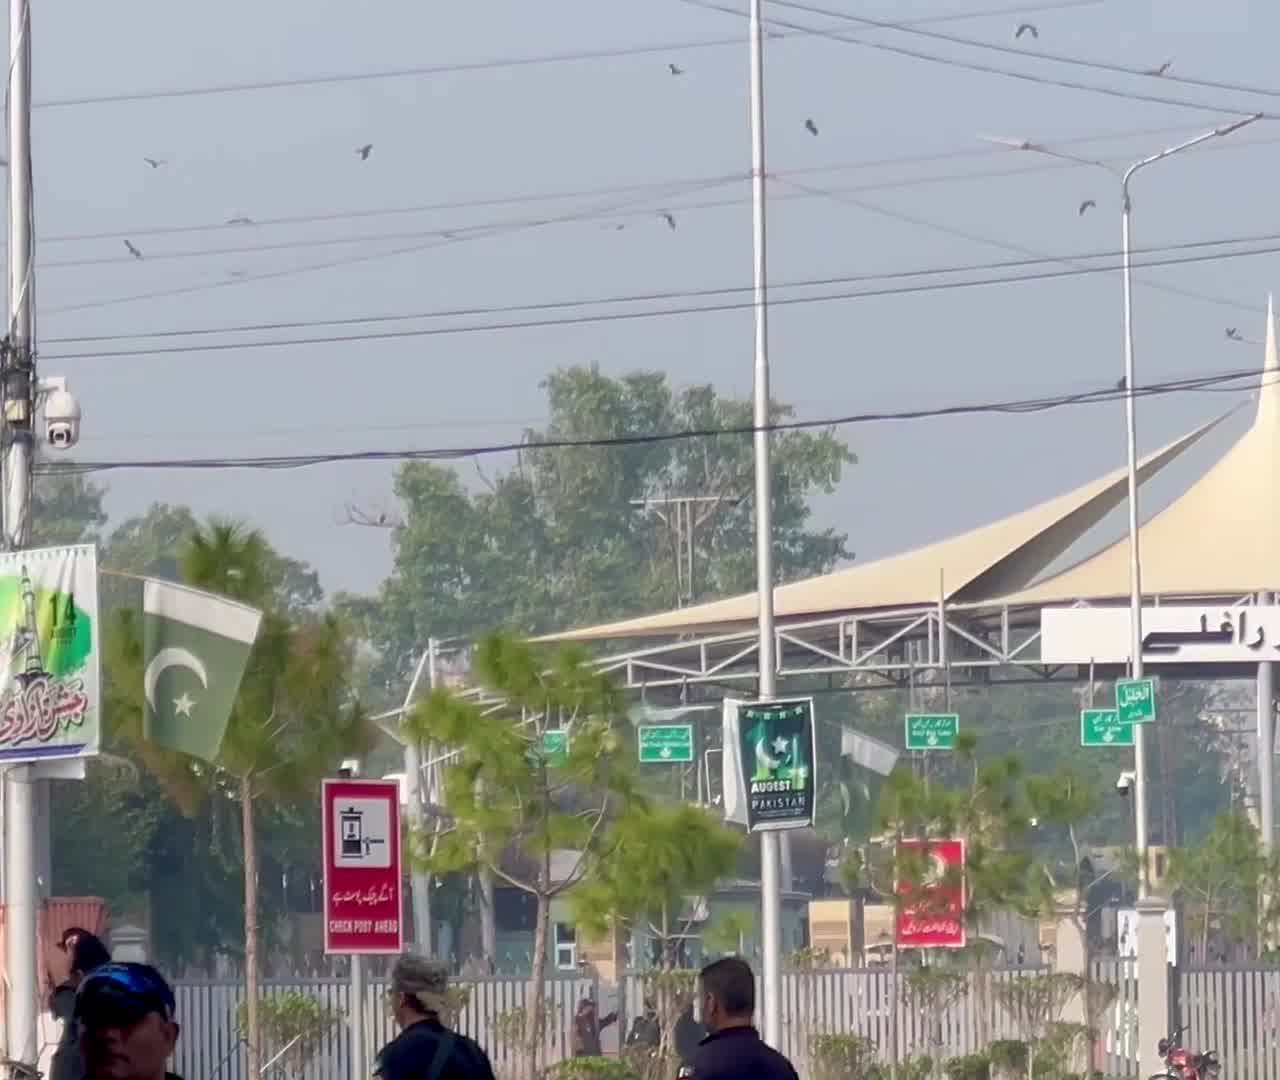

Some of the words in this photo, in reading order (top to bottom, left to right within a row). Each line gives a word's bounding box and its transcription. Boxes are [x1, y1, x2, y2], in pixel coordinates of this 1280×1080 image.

[49, 592, 77, 626] 14
[751, 796, 806, 810] PAKISTAN
[329, 919, 352, 934] CHECK
[353, 919, 372, 934] POST
[374, 919, 398, 934] AHEAD
